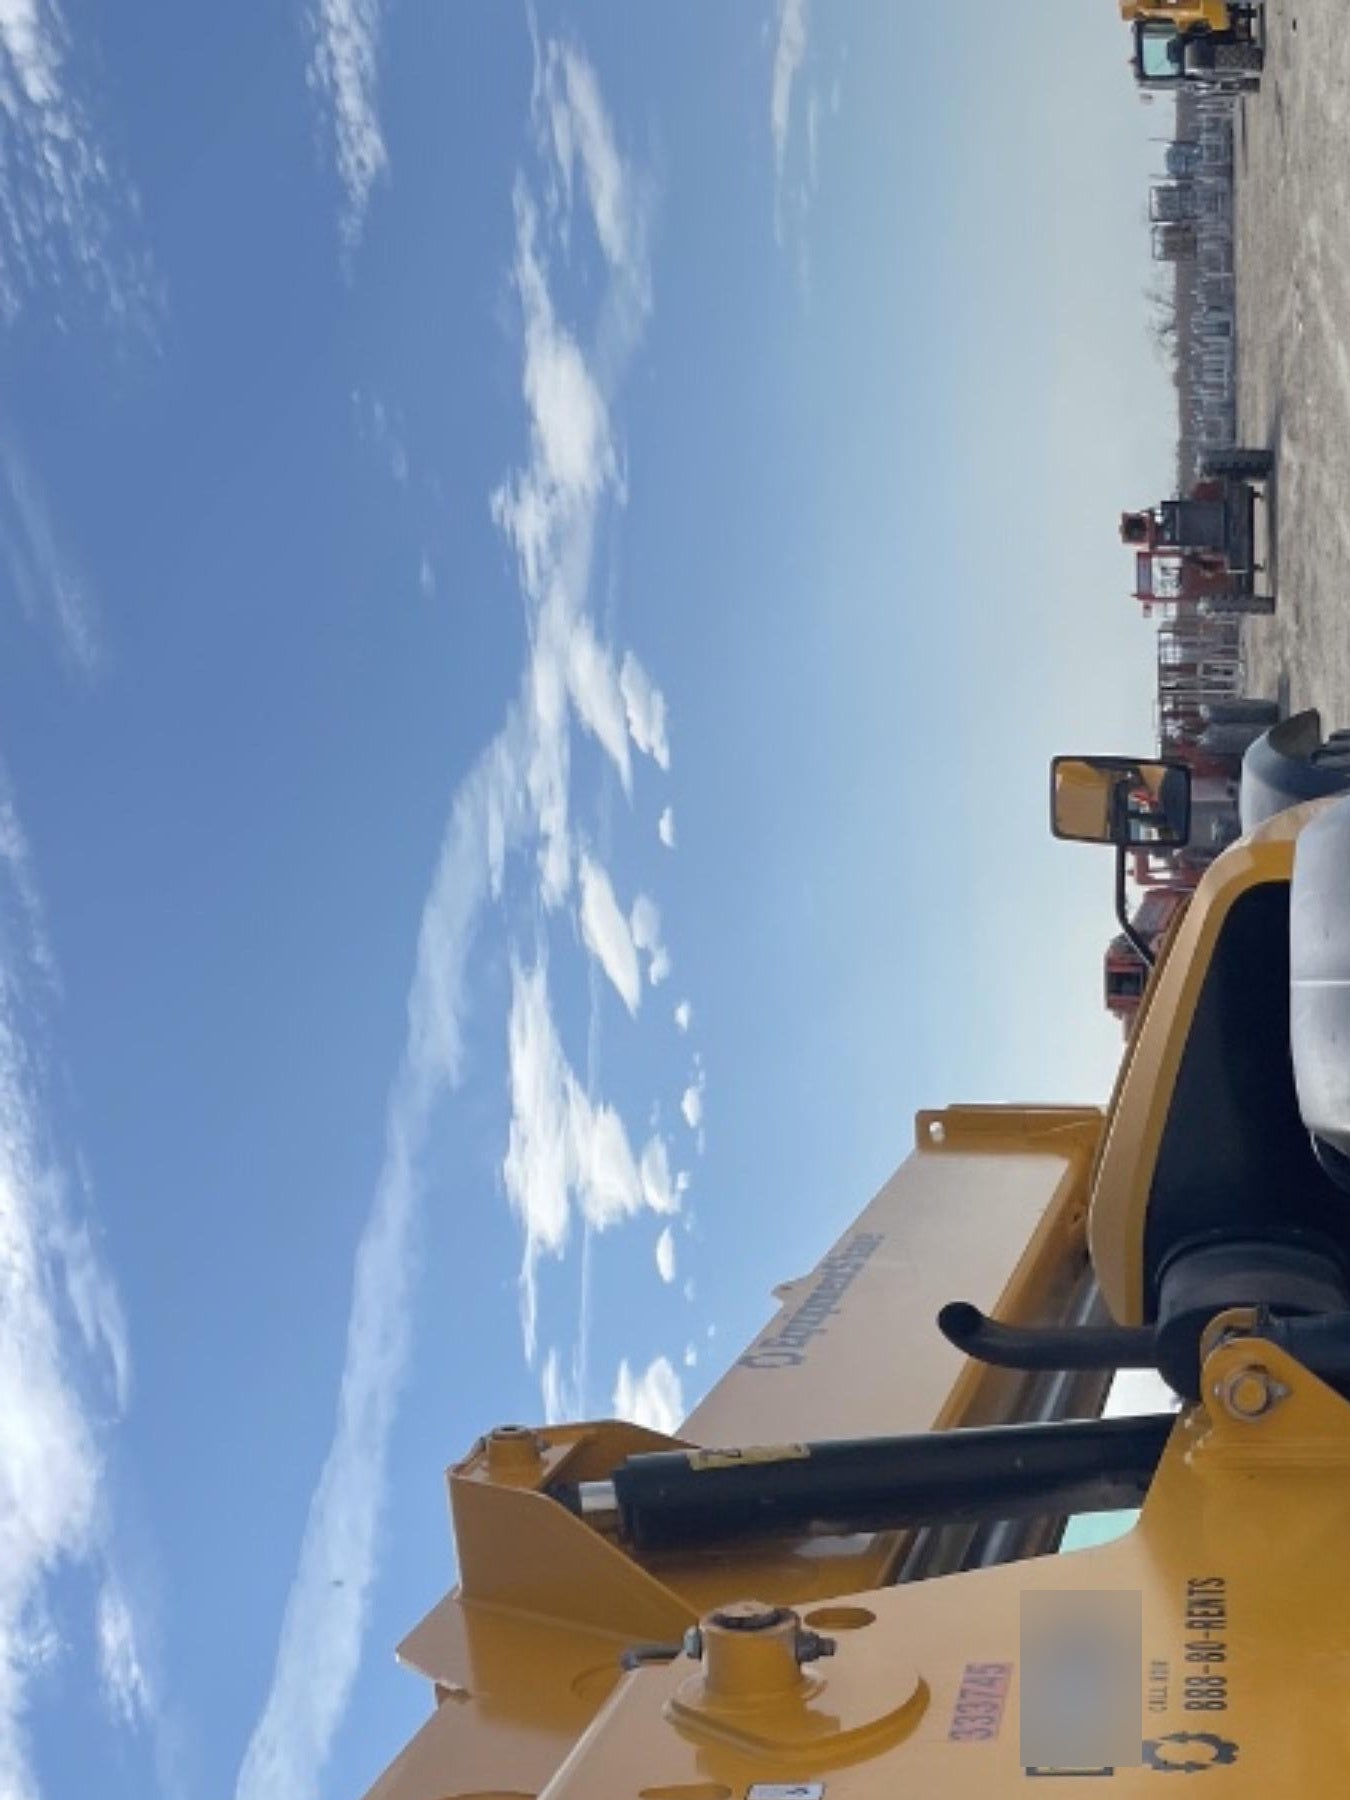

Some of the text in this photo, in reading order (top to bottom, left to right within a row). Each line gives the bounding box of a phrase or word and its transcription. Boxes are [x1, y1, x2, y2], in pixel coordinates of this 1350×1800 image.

[757, 1232, 885, 1350] EquipmentShare
[949, 1662, 1005, 1742] 333745
[1184, 1576, 1228, 1712] 888-80-RENTS
